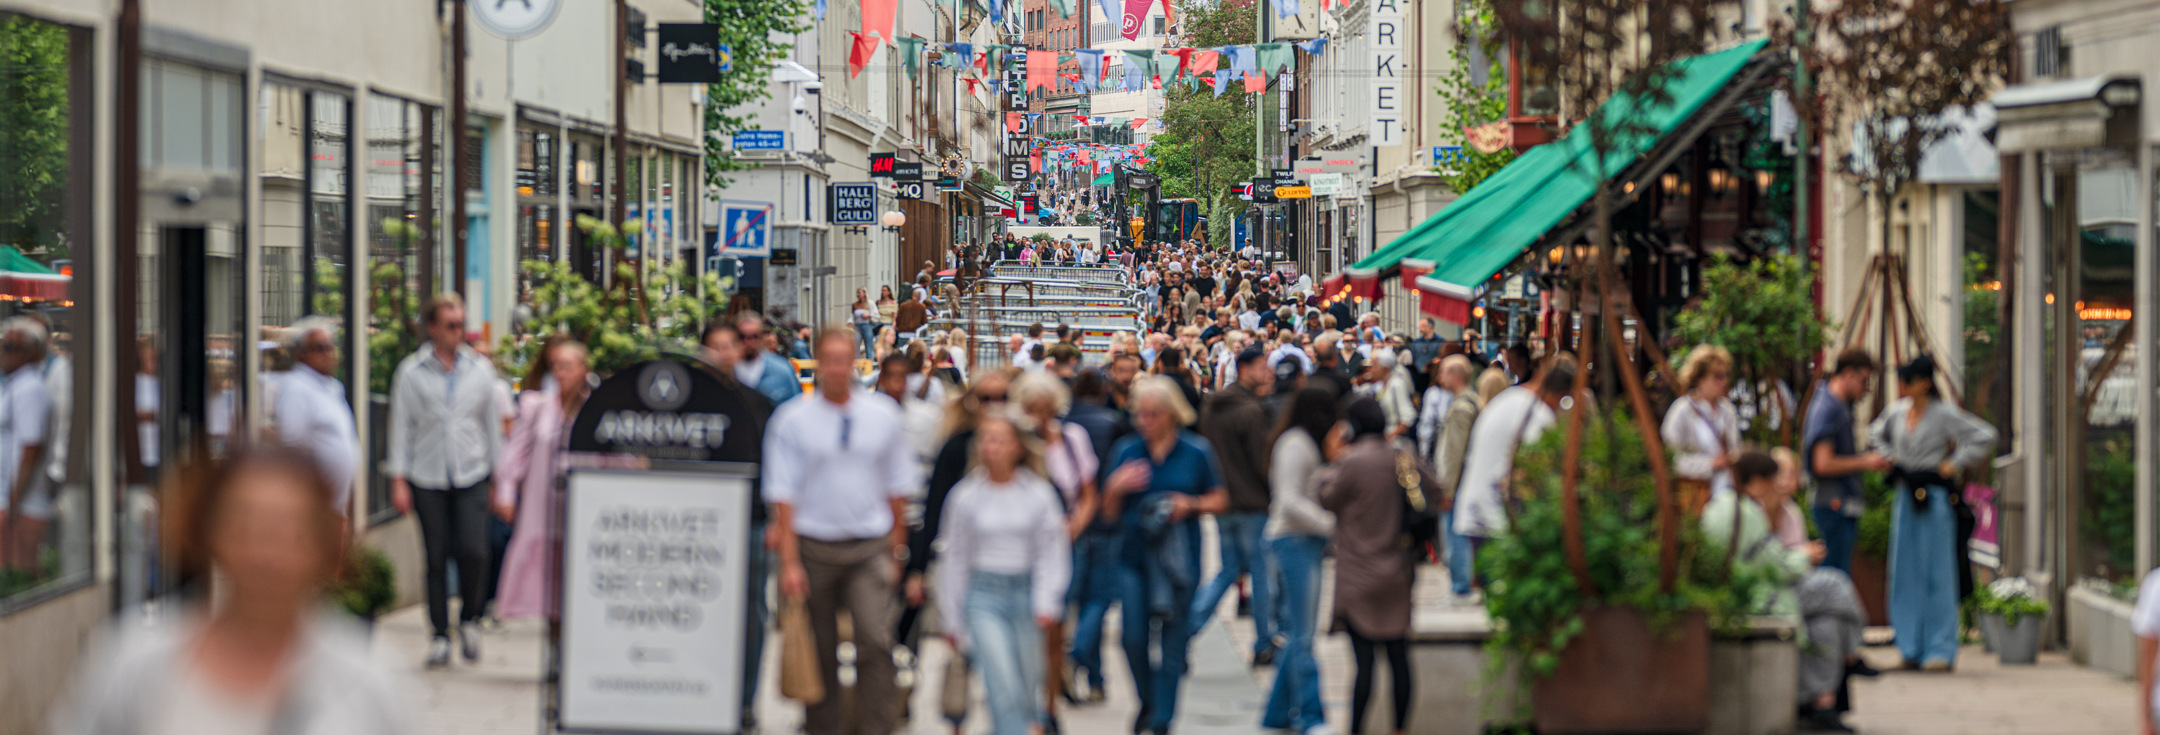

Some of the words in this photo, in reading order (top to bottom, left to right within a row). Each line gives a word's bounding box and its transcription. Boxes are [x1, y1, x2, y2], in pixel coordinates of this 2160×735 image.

[872, 157, 894, 173] H&M
[838, 187, 871, 198] HALL
[897, 183, 921, 198] MQ
[838, 198, 872, 209] BERG
[838, 210, 873, 221] GULD
